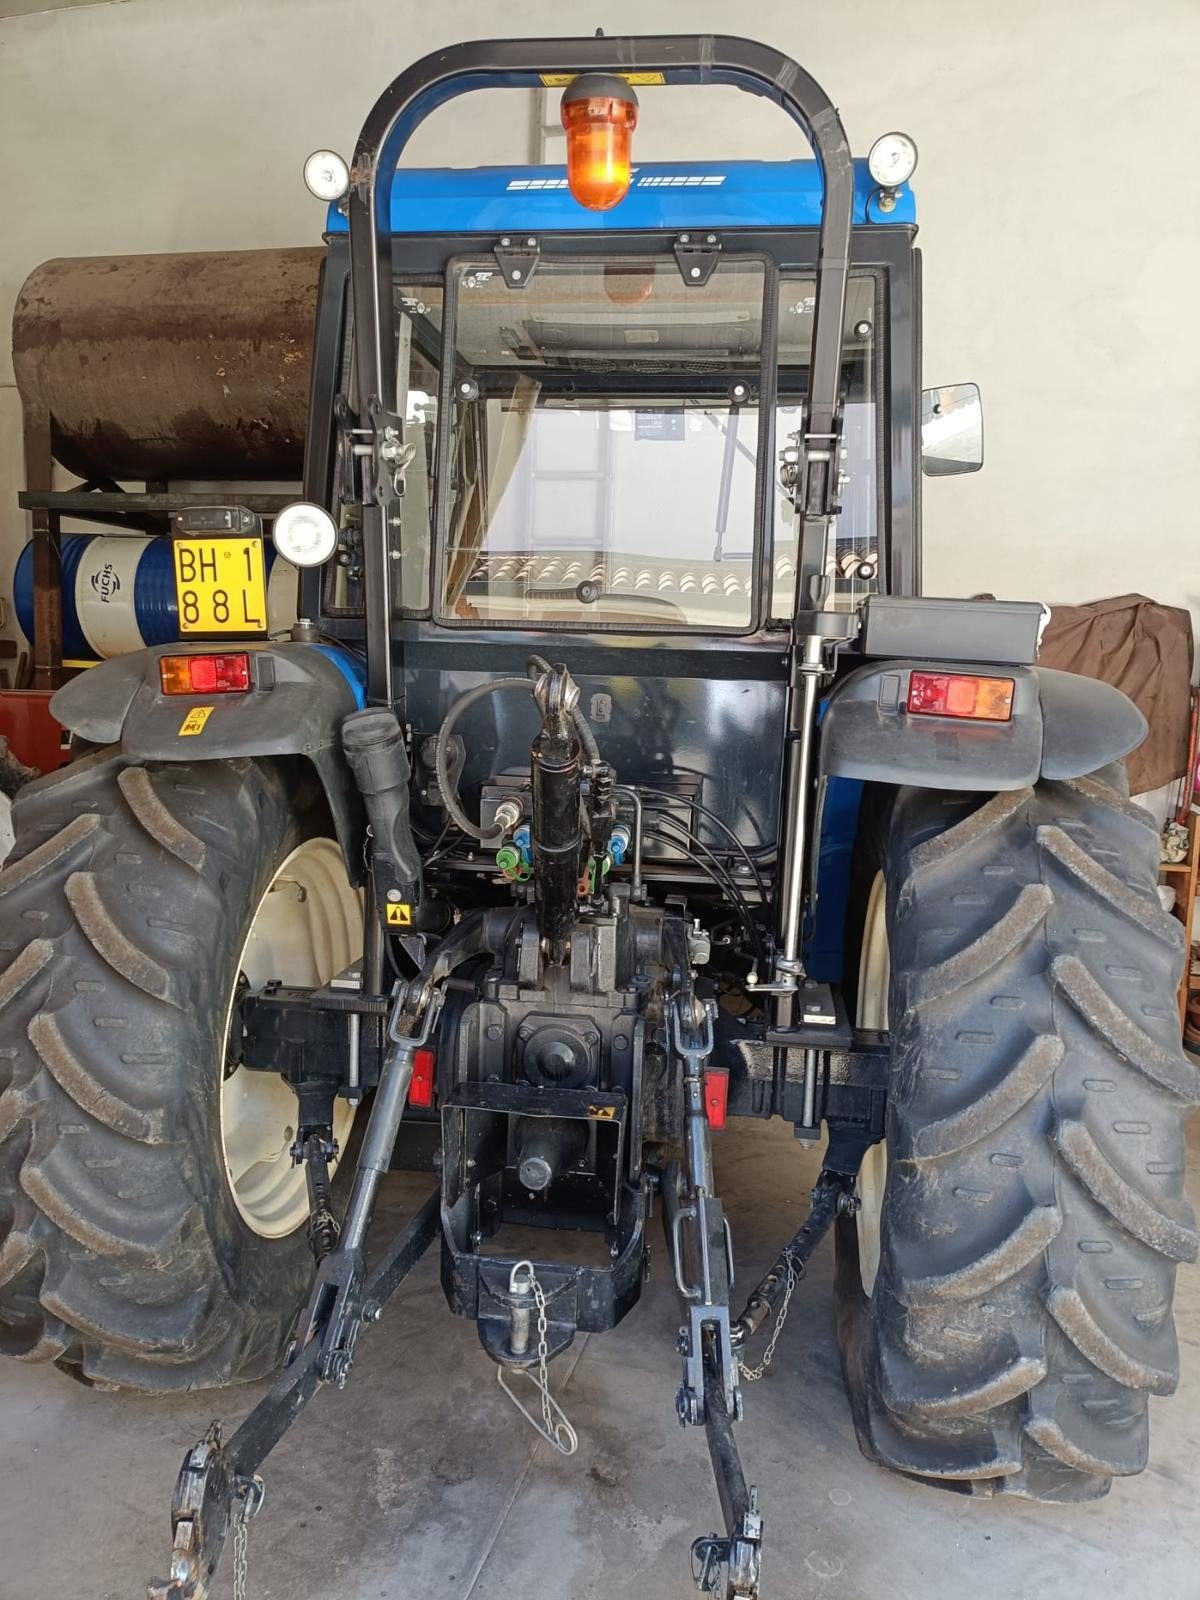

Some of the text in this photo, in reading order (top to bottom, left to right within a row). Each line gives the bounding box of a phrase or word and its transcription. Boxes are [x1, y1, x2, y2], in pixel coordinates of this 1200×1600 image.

[101, 563, 113, 603] FUCHS
[180, 547, 252, 582] BH 1
